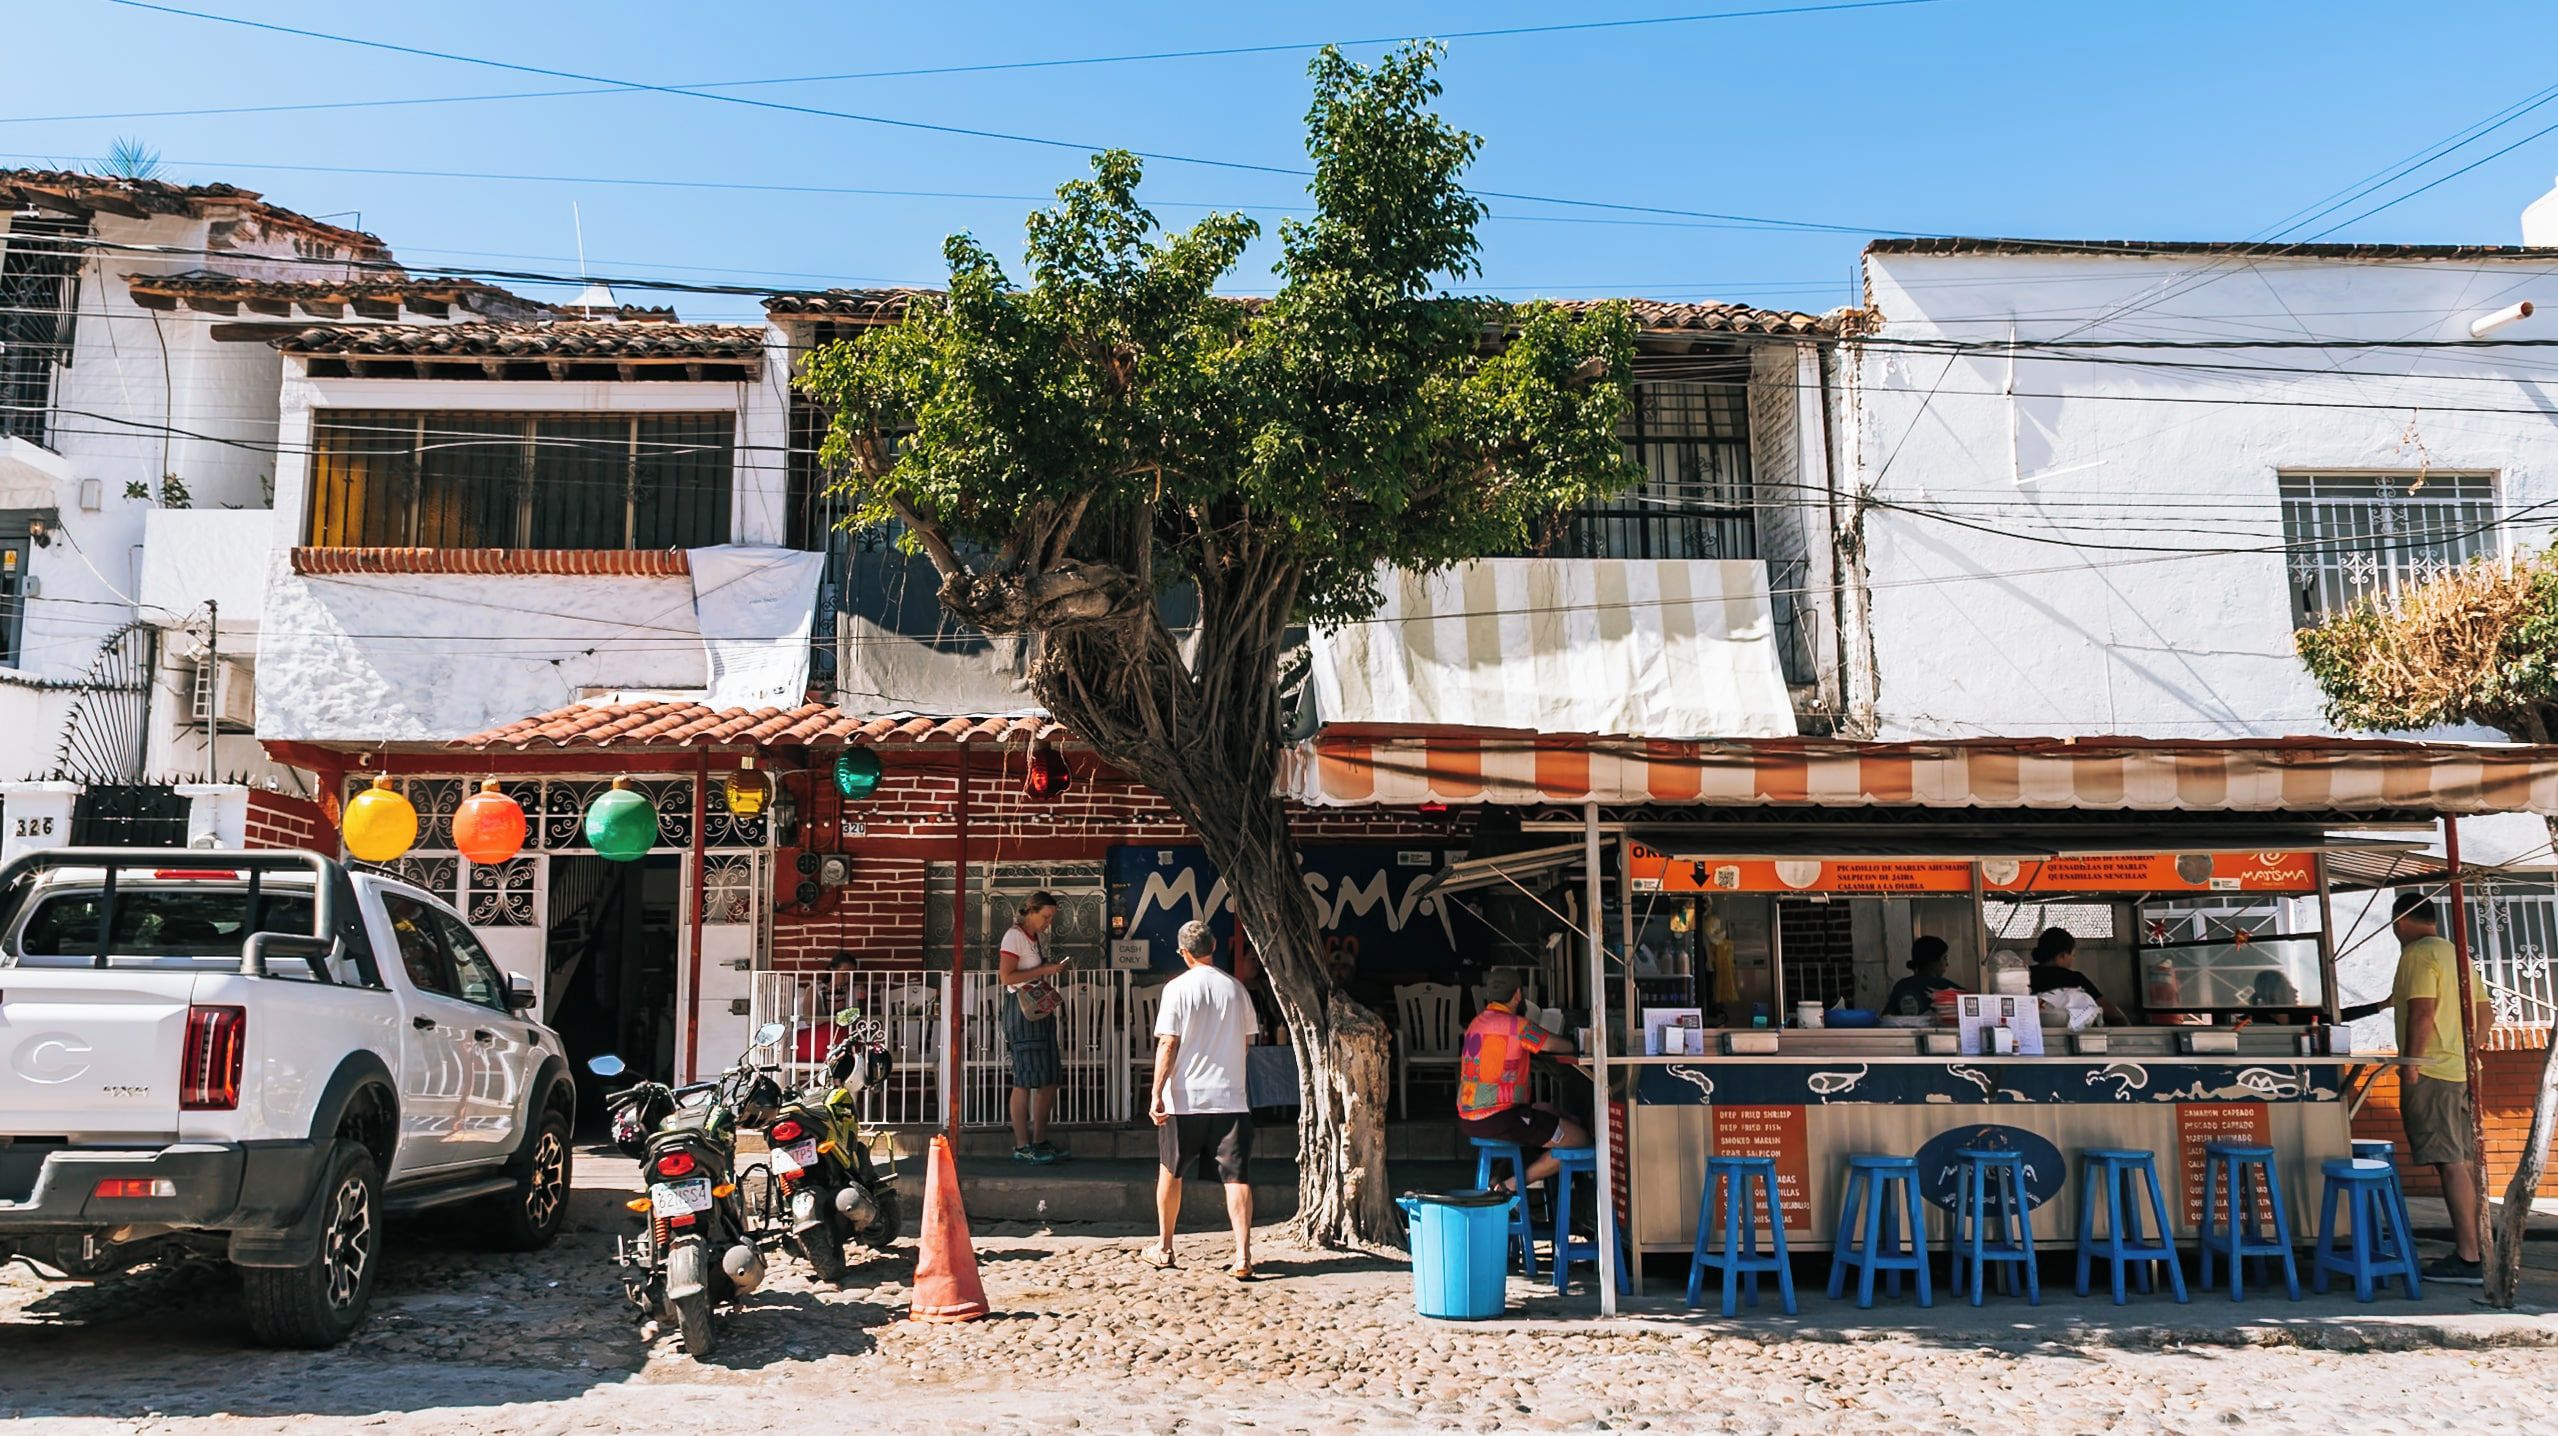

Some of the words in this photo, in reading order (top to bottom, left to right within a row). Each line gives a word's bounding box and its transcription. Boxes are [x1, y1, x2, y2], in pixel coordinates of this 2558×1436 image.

[16, 817, 54, 837] 326
[843, 823, 865, 834] 320
[1836, 864, 1880, 872] PICADILLO
[1836, 873, 1877, 881] SALPICON
[2048, 873, 2102, 881] QUESADILLAS
[1119, 945, 1141, 953] CASH
[1119, 956, 1141, 964] ONLY
[1719, 1110, 1737, 1119] DEEP
[1741, 1110, 1761, 1119] FRIED
[1763, 1110, 1792, 1119] SHRIMP
[2222, 1108, 2255, 1116] CAPEADO
[1719, 1124, 1738, 1132] DEEP
[1741, 1124, 1761, 1132] FRIED
[2221, 1121, 2254, 1129] CAPEADO
[1720, 1136, 1751, 1145] SMOKED
[1753, 1136, 1781, 1144] MARLIN
